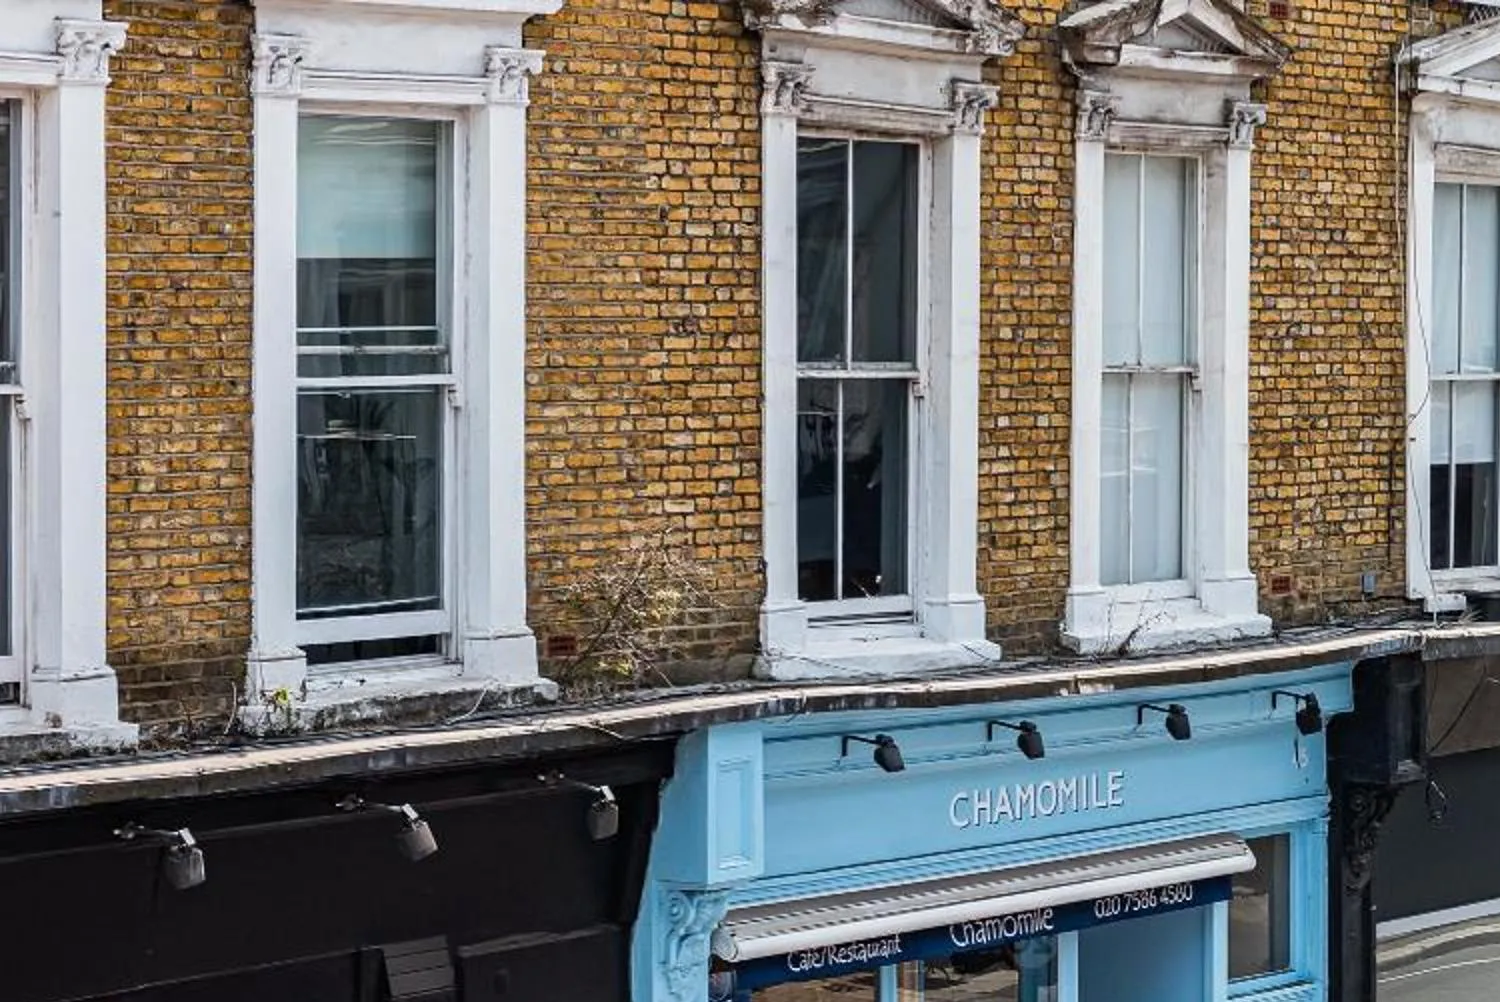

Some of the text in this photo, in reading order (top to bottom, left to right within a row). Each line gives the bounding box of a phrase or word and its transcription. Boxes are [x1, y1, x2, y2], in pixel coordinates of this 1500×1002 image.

[950, 769, 1125, 830] CHAMOMILE
[950, 907, 1054, 947] Chamomile
[1094, 898, 1121, 918] 020
[1123, 890, 1157, 913] 7586
